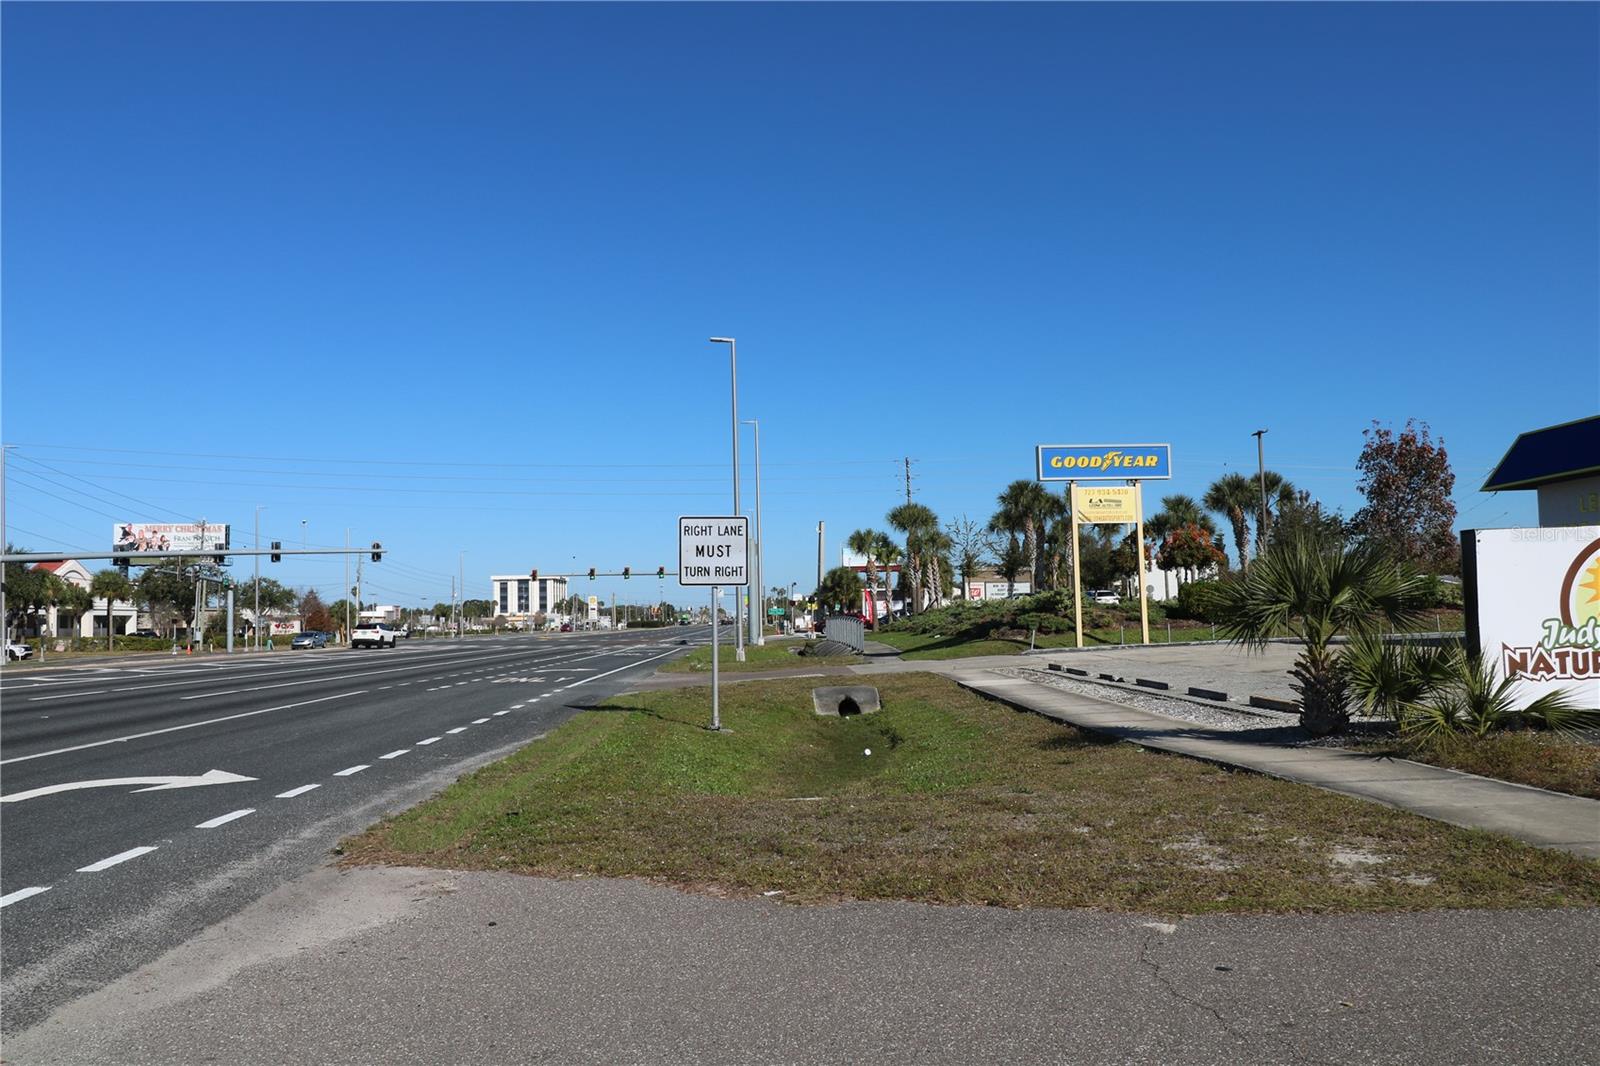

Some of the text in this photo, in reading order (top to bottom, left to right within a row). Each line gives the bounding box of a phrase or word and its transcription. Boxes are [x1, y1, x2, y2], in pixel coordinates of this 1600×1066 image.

[1050, 453, 1158, 469] GOODYEAR
[144, 525, 173, 533] MERRY
[683, 525, 744, 537] RIGHT LANE
[695, 544, 732, 558] MUST
[684, 566, 744, 577] TURN RIGHT
